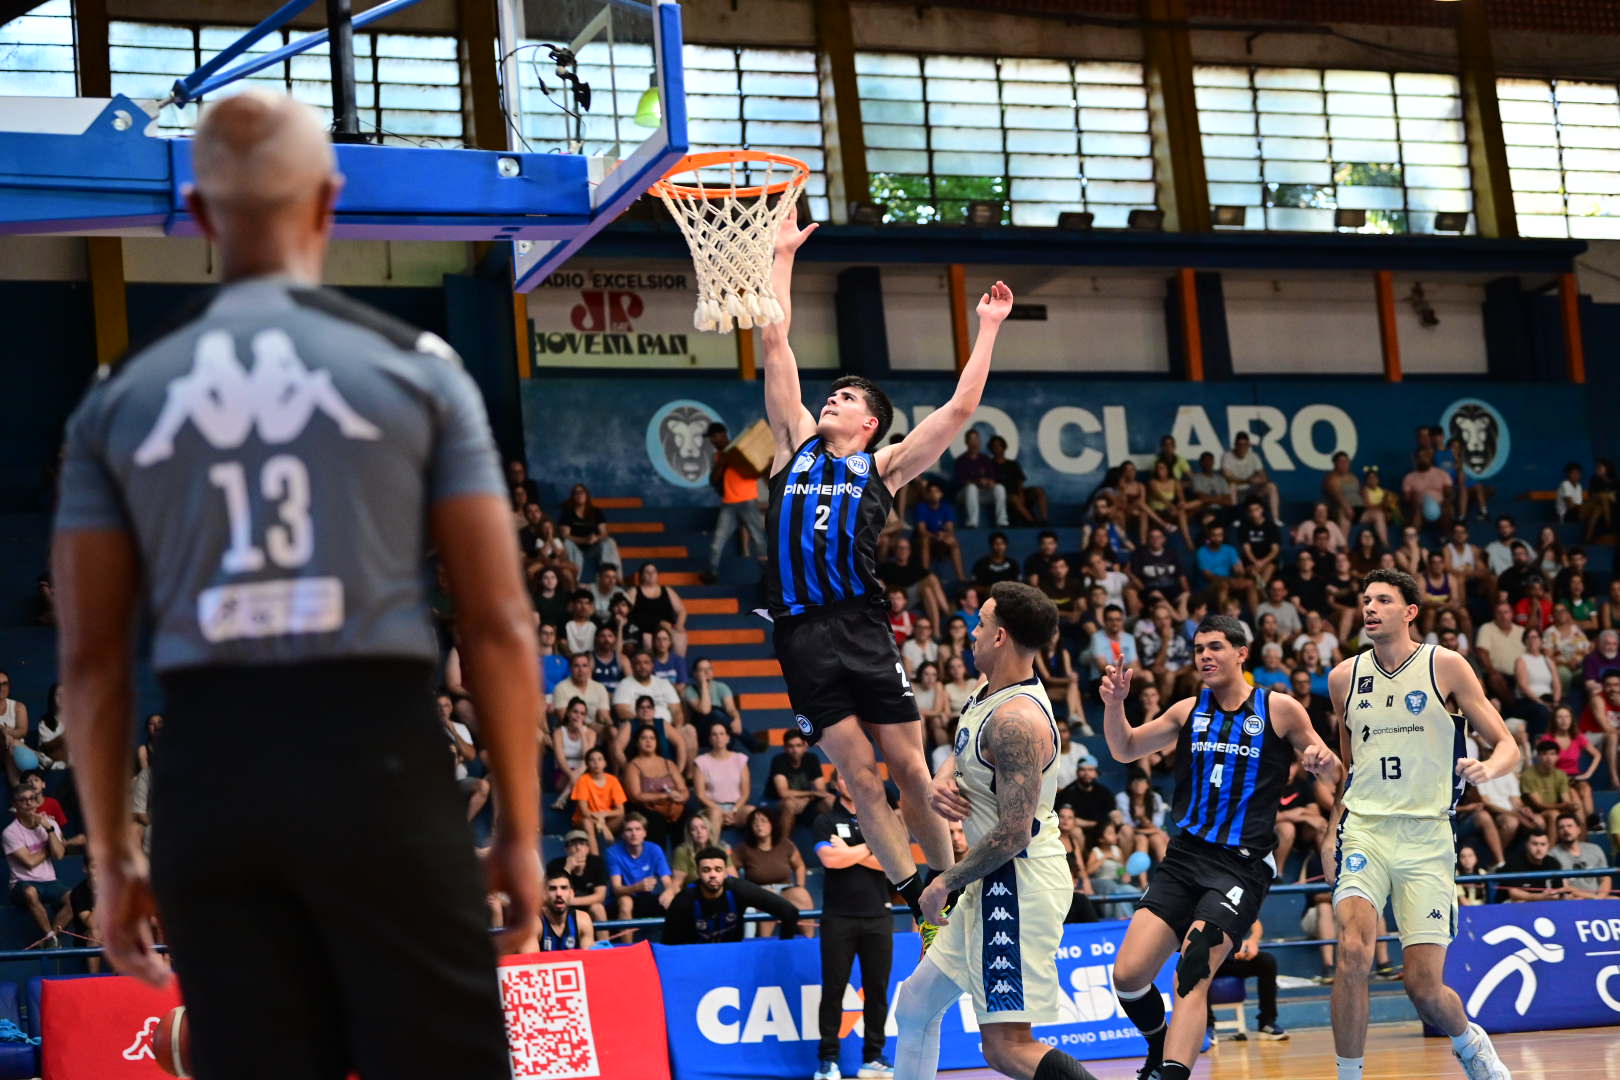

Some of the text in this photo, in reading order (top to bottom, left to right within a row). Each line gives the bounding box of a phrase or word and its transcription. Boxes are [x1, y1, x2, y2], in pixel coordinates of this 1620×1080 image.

[538, 272, 687, 289] ADIO EXCELSIOR
[637, 334, 688, 355] PAN
[1038, 404, 1358, 475] CLARO
[784, 482, 863, 498] PINHEIROS
[208, 454, 315, 574] 13
[814, 505, 831, 530] 2
[895, 662, 910, 688] 2
[1191, 741, 1261, 758] PINHEIROS
[1209, 763, 1224, 788] 4
[1380, 756, 1402, 780] 13
[1225, 885, 1244, 906] 4
[1575, 919, 1620, 943] FOR
[1090, 942, 1116, 957] DO
[1061, 1032, 1096, 1045] POVO
[1099, 1027, 1140, 1041] BRASIL
